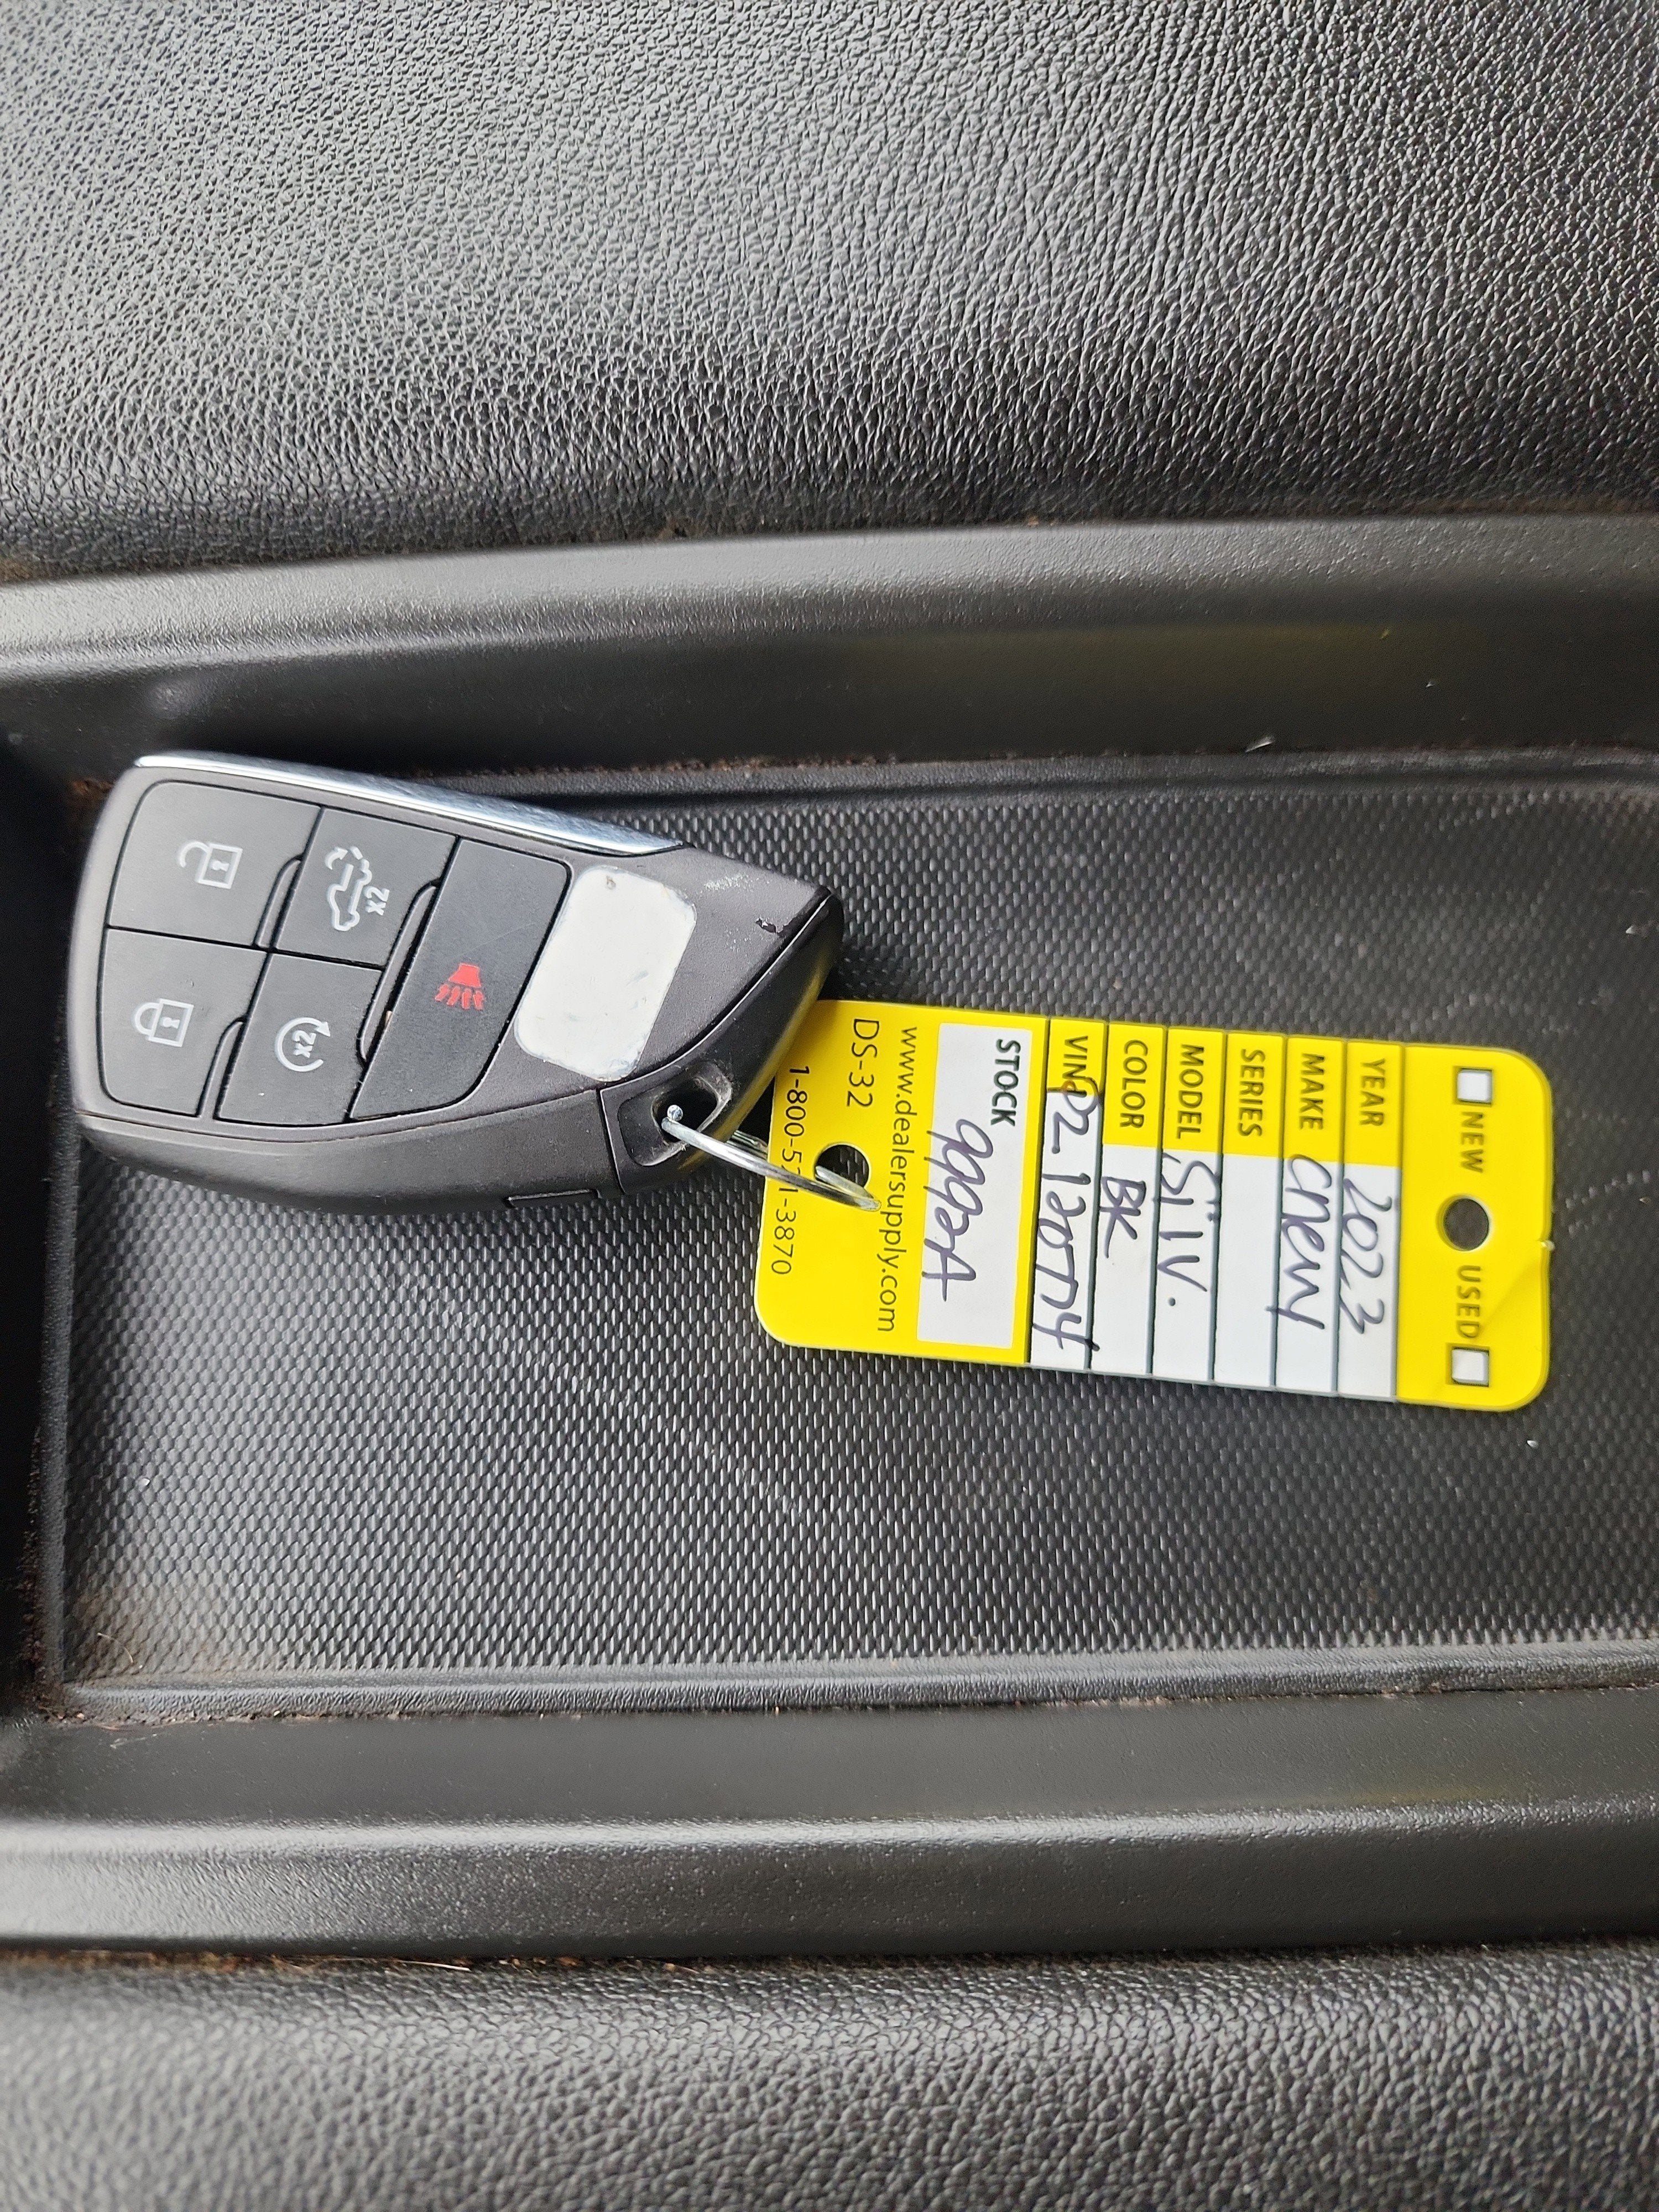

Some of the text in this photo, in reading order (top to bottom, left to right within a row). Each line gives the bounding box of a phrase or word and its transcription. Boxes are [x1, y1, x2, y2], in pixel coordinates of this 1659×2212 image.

[363, 885, 390, 916] x2
[291, 1030, 317, 1058] x2
[846, 1018, 880, 1108] DS-32
[990, 1039, 1021, 1128] STOCK
[1062, 1035, 1089, 1080] VIN
[1120, 1039, 1149, 1130] COLOR
[1176, 1044, 1204, 1140] MODEL
[1237, 1048, 1266, 1138] SERIES
[1298, 1052, 1325, 1130] MAKE
[1359, 1057, 1386, 1127] YEAR
[877, 1026, 918, 1332] www.dealersupply.com
[1459, 1110, 1484, 1173] NEW
[1099, 1175, 1147, 1259] BK
[1338, 1178, 1392, 1334] 2023
[1455, 1265, 1482, 1338] USED
